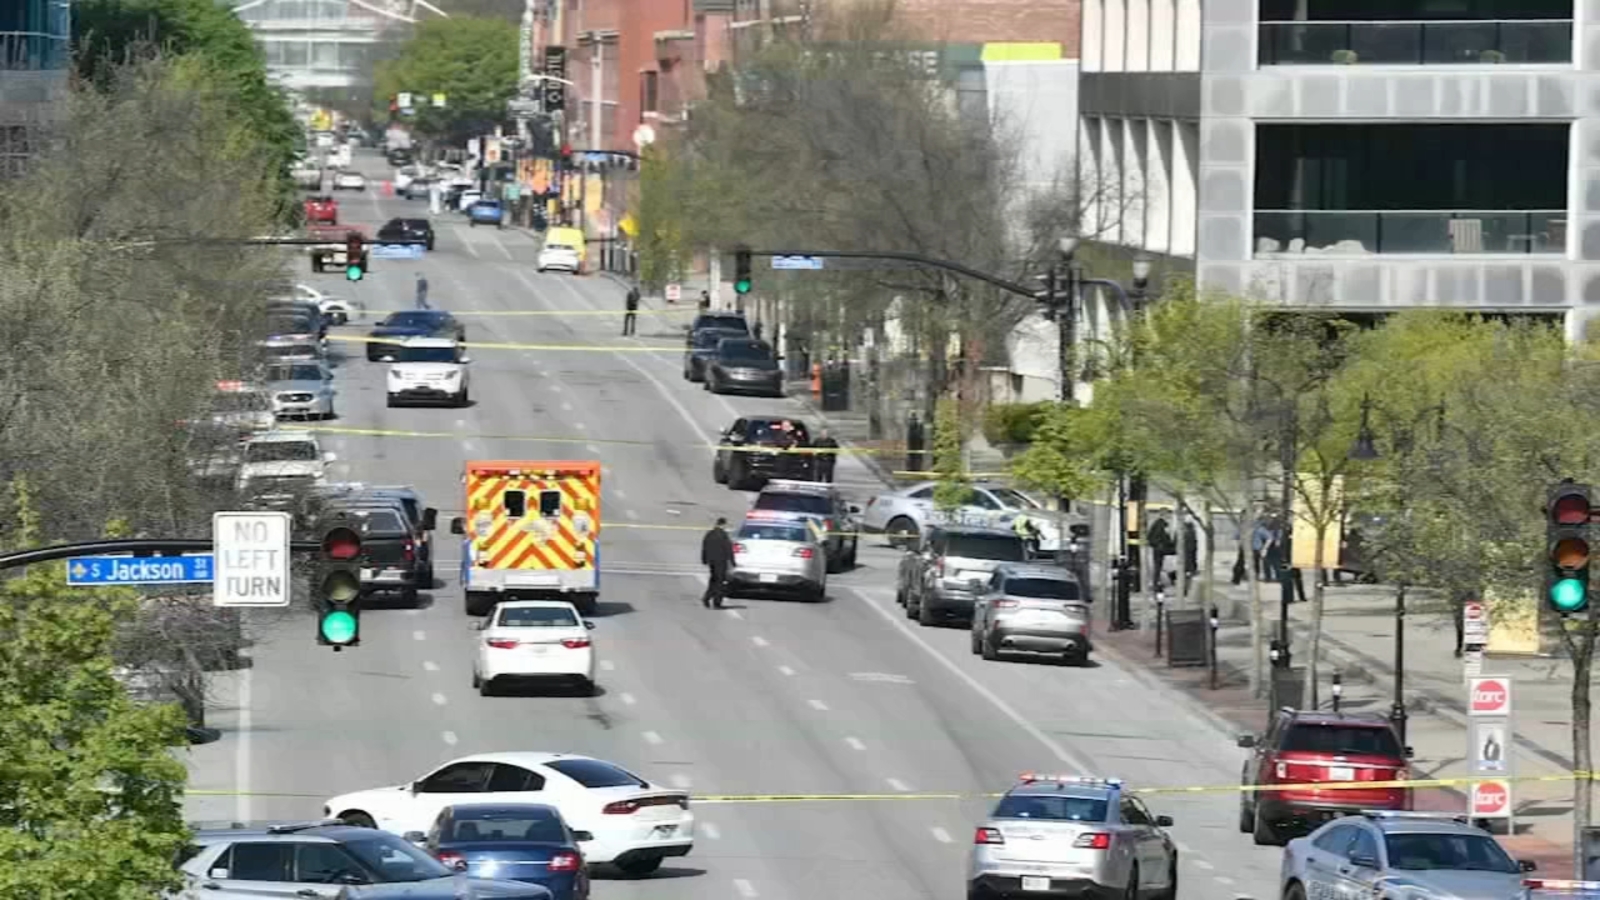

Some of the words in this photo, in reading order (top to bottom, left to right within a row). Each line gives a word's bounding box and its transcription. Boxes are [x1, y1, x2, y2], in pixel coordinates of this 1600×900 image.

[545, 53, 563, 90] DSTIL
[234, 521, 268, 543] NO
[91, 563, 101, 577] S
[106, 559, 184, 580] Jackson
[224, 549, 279, 570] LEFT
[226, 576, 281, 597] TURN
